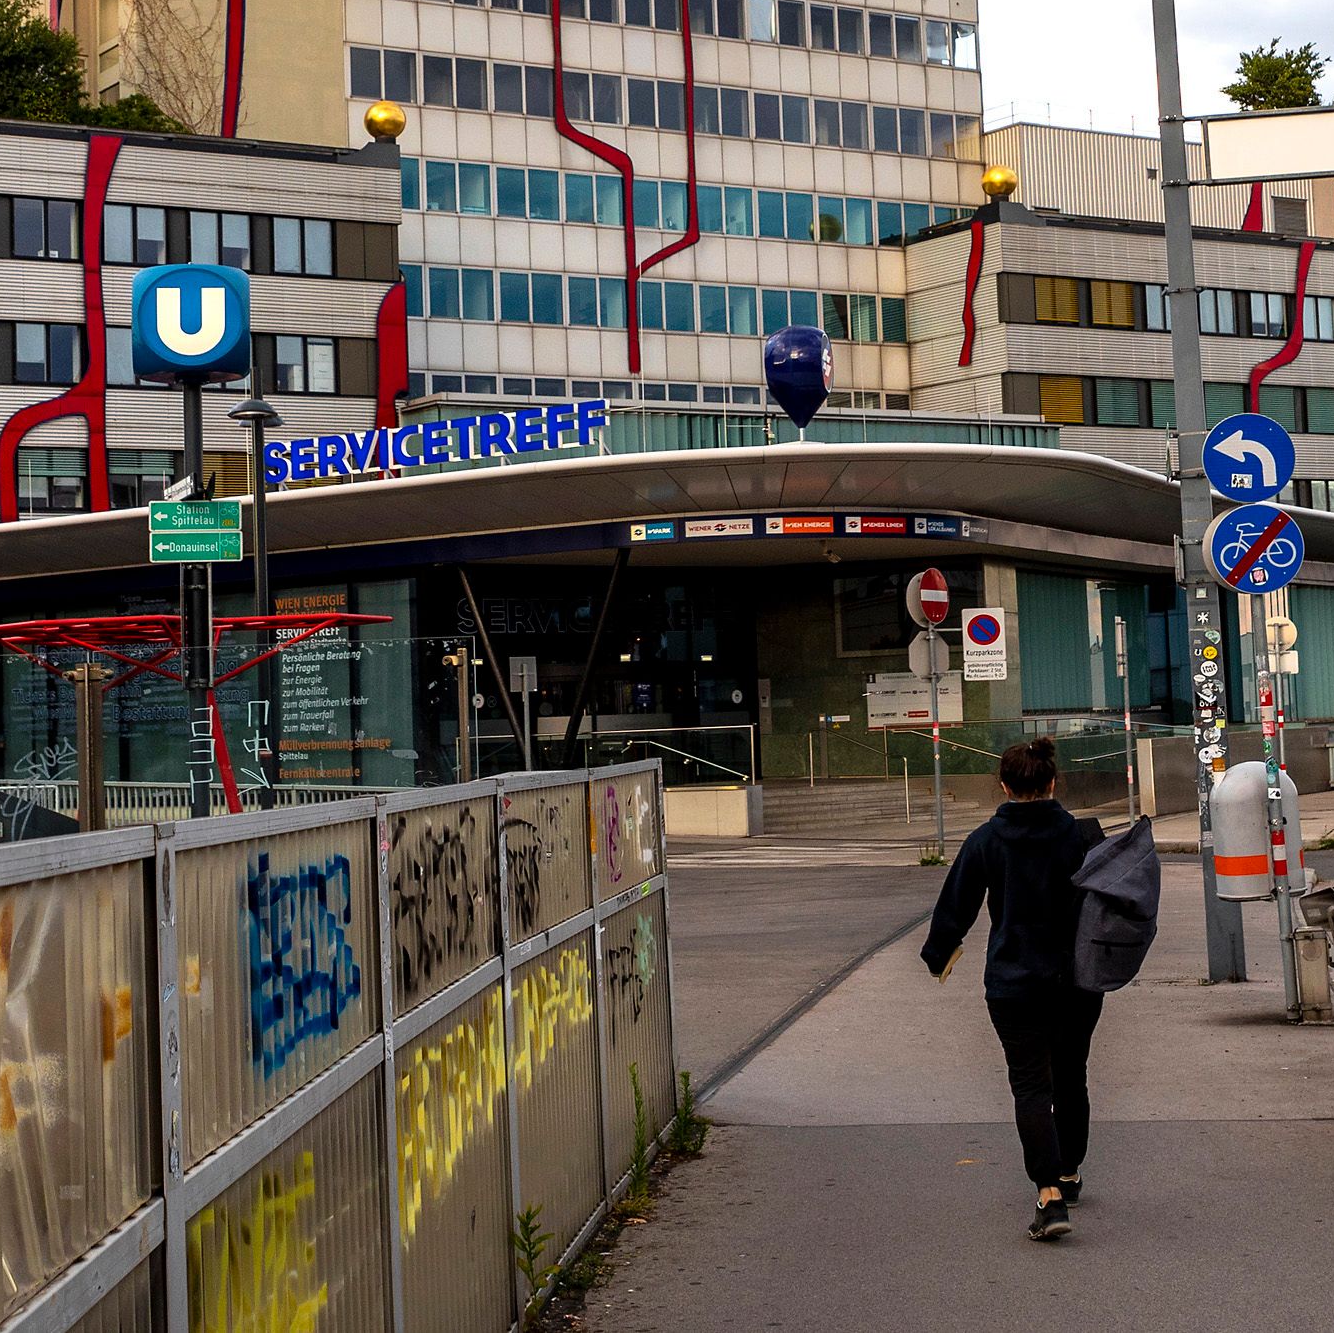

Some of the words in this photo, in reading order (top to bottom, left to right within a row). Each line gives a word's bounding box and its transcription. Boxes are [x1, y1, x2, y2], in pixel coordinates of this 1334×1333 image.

[156, 287, 226, 356] U
[264, 398, 610, 484] SERVICETREFF
[176, 504, 210, 515] Station
[171, 515, 215, 527] Spittelau
[169, 541, 219, 552] Donauinsel
[275, 597, 301, 609] WIEN
[303, 594, 347, 608] ENERGIE
[282, 652, 325, 663] Persönliche
[282, 664, 294, 673] bei
[295, 664, 320, 674] Fragen
[282, 677, 294, 686] zur
[295, 675, 322, 685] Energie
[282, 689, 294, 697] zur
[295, 687, 328, 696] Mobilität
[282, 701, 297, 709] zum
[298, 698, 339, 710] öffentlichen
[341, 696, 369, 707] Verkehr
[299, 710, 334, 722] Trauerfall
[278, 737, 392, 752] Müllverbrennungsanlage
[278, 752, 308, 762] Spittelau
[279, 766, 361, 779] Fernkältezentrale
